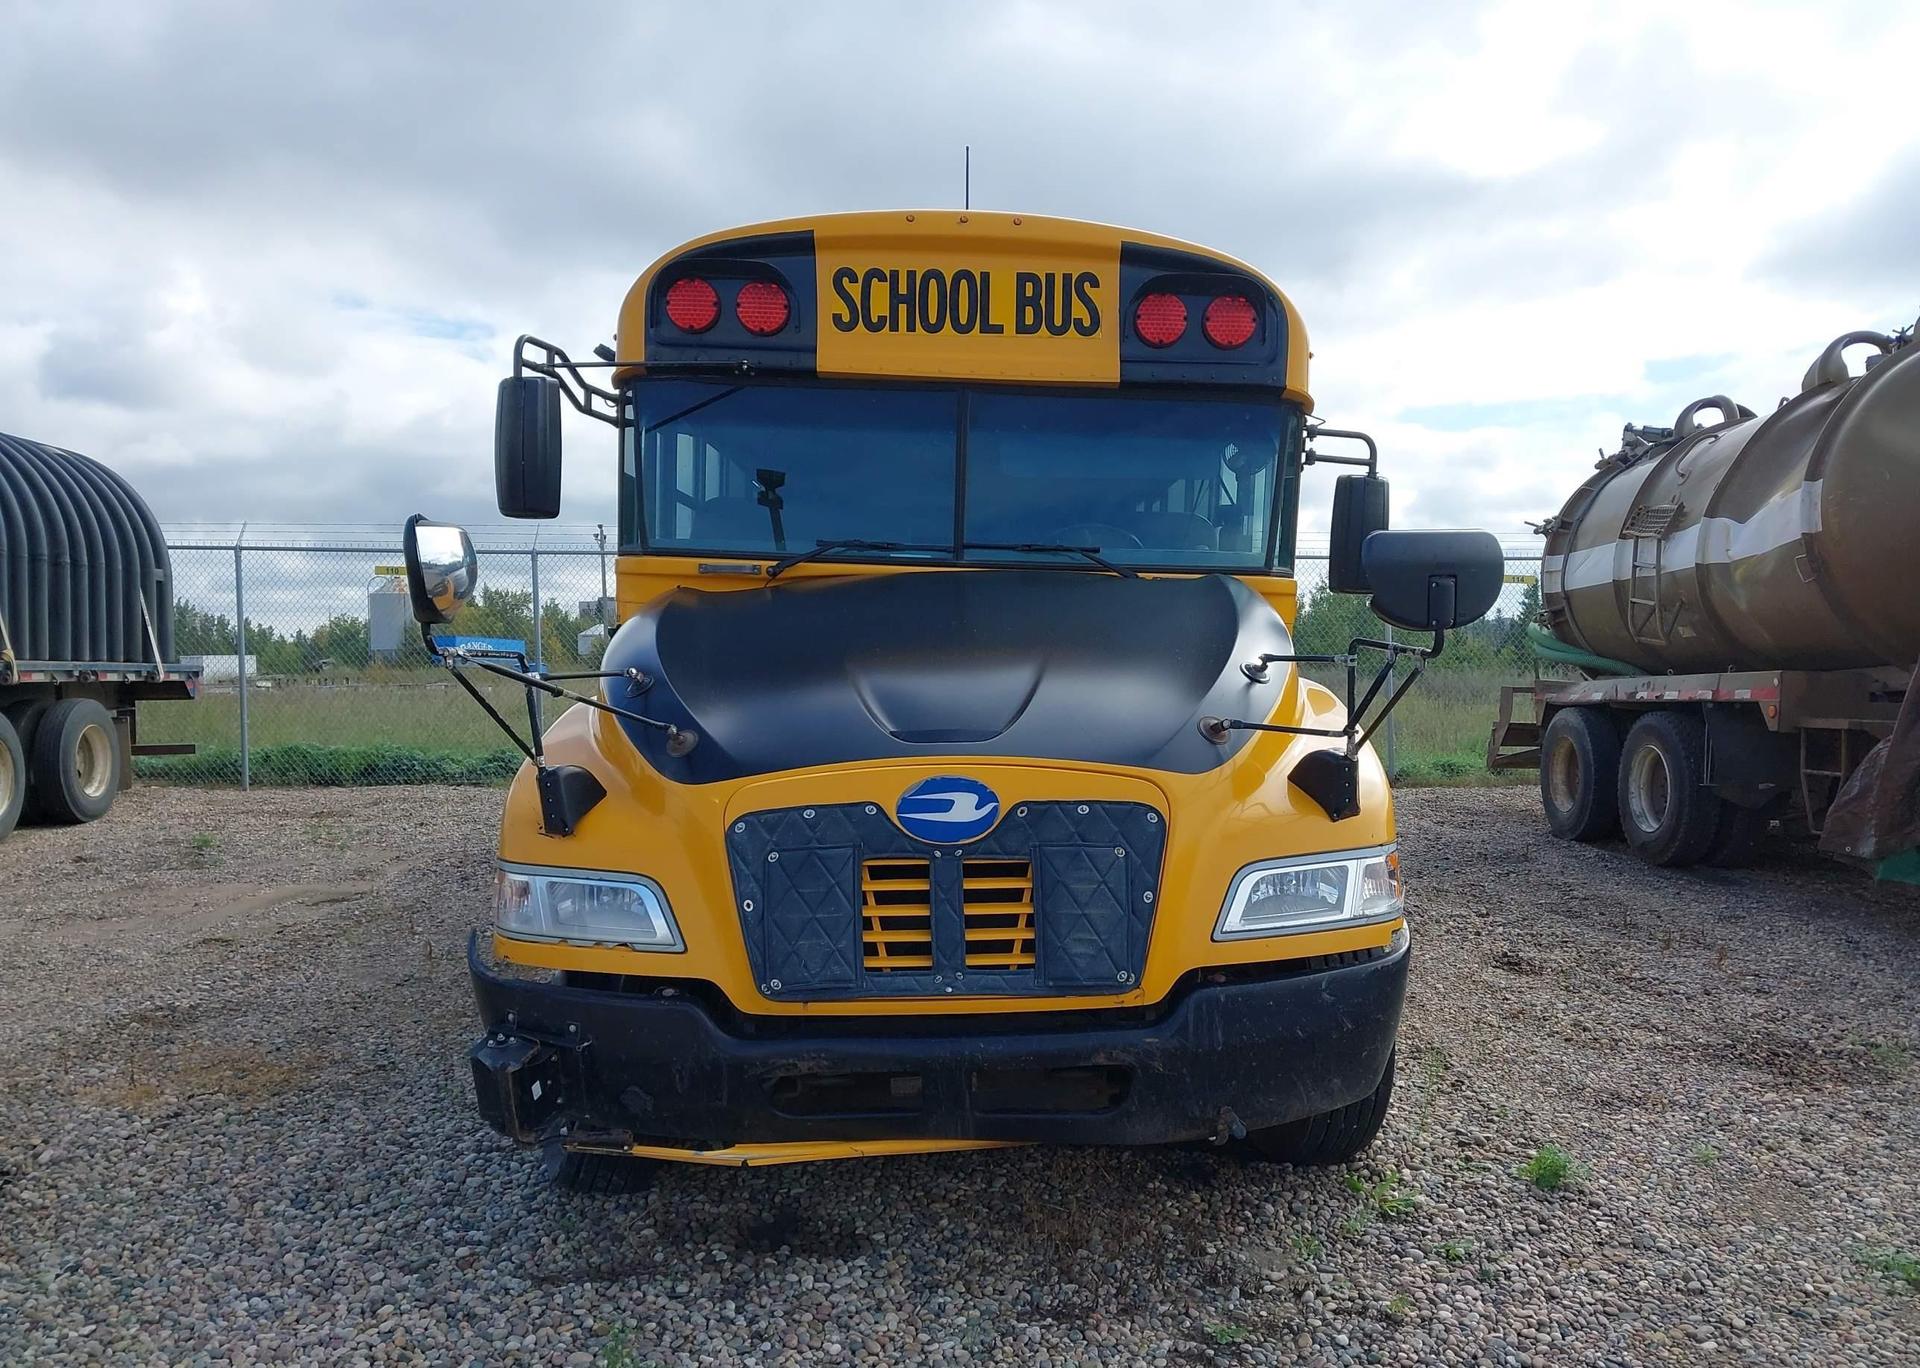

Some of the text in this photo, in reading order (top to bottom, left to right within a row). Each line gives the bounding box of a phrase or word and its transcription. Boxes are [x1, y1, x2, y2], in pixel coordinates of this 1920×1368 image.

[832, 266, 1100, 337] SCHOOL BUS
[385, 567, 400, 575] 110
